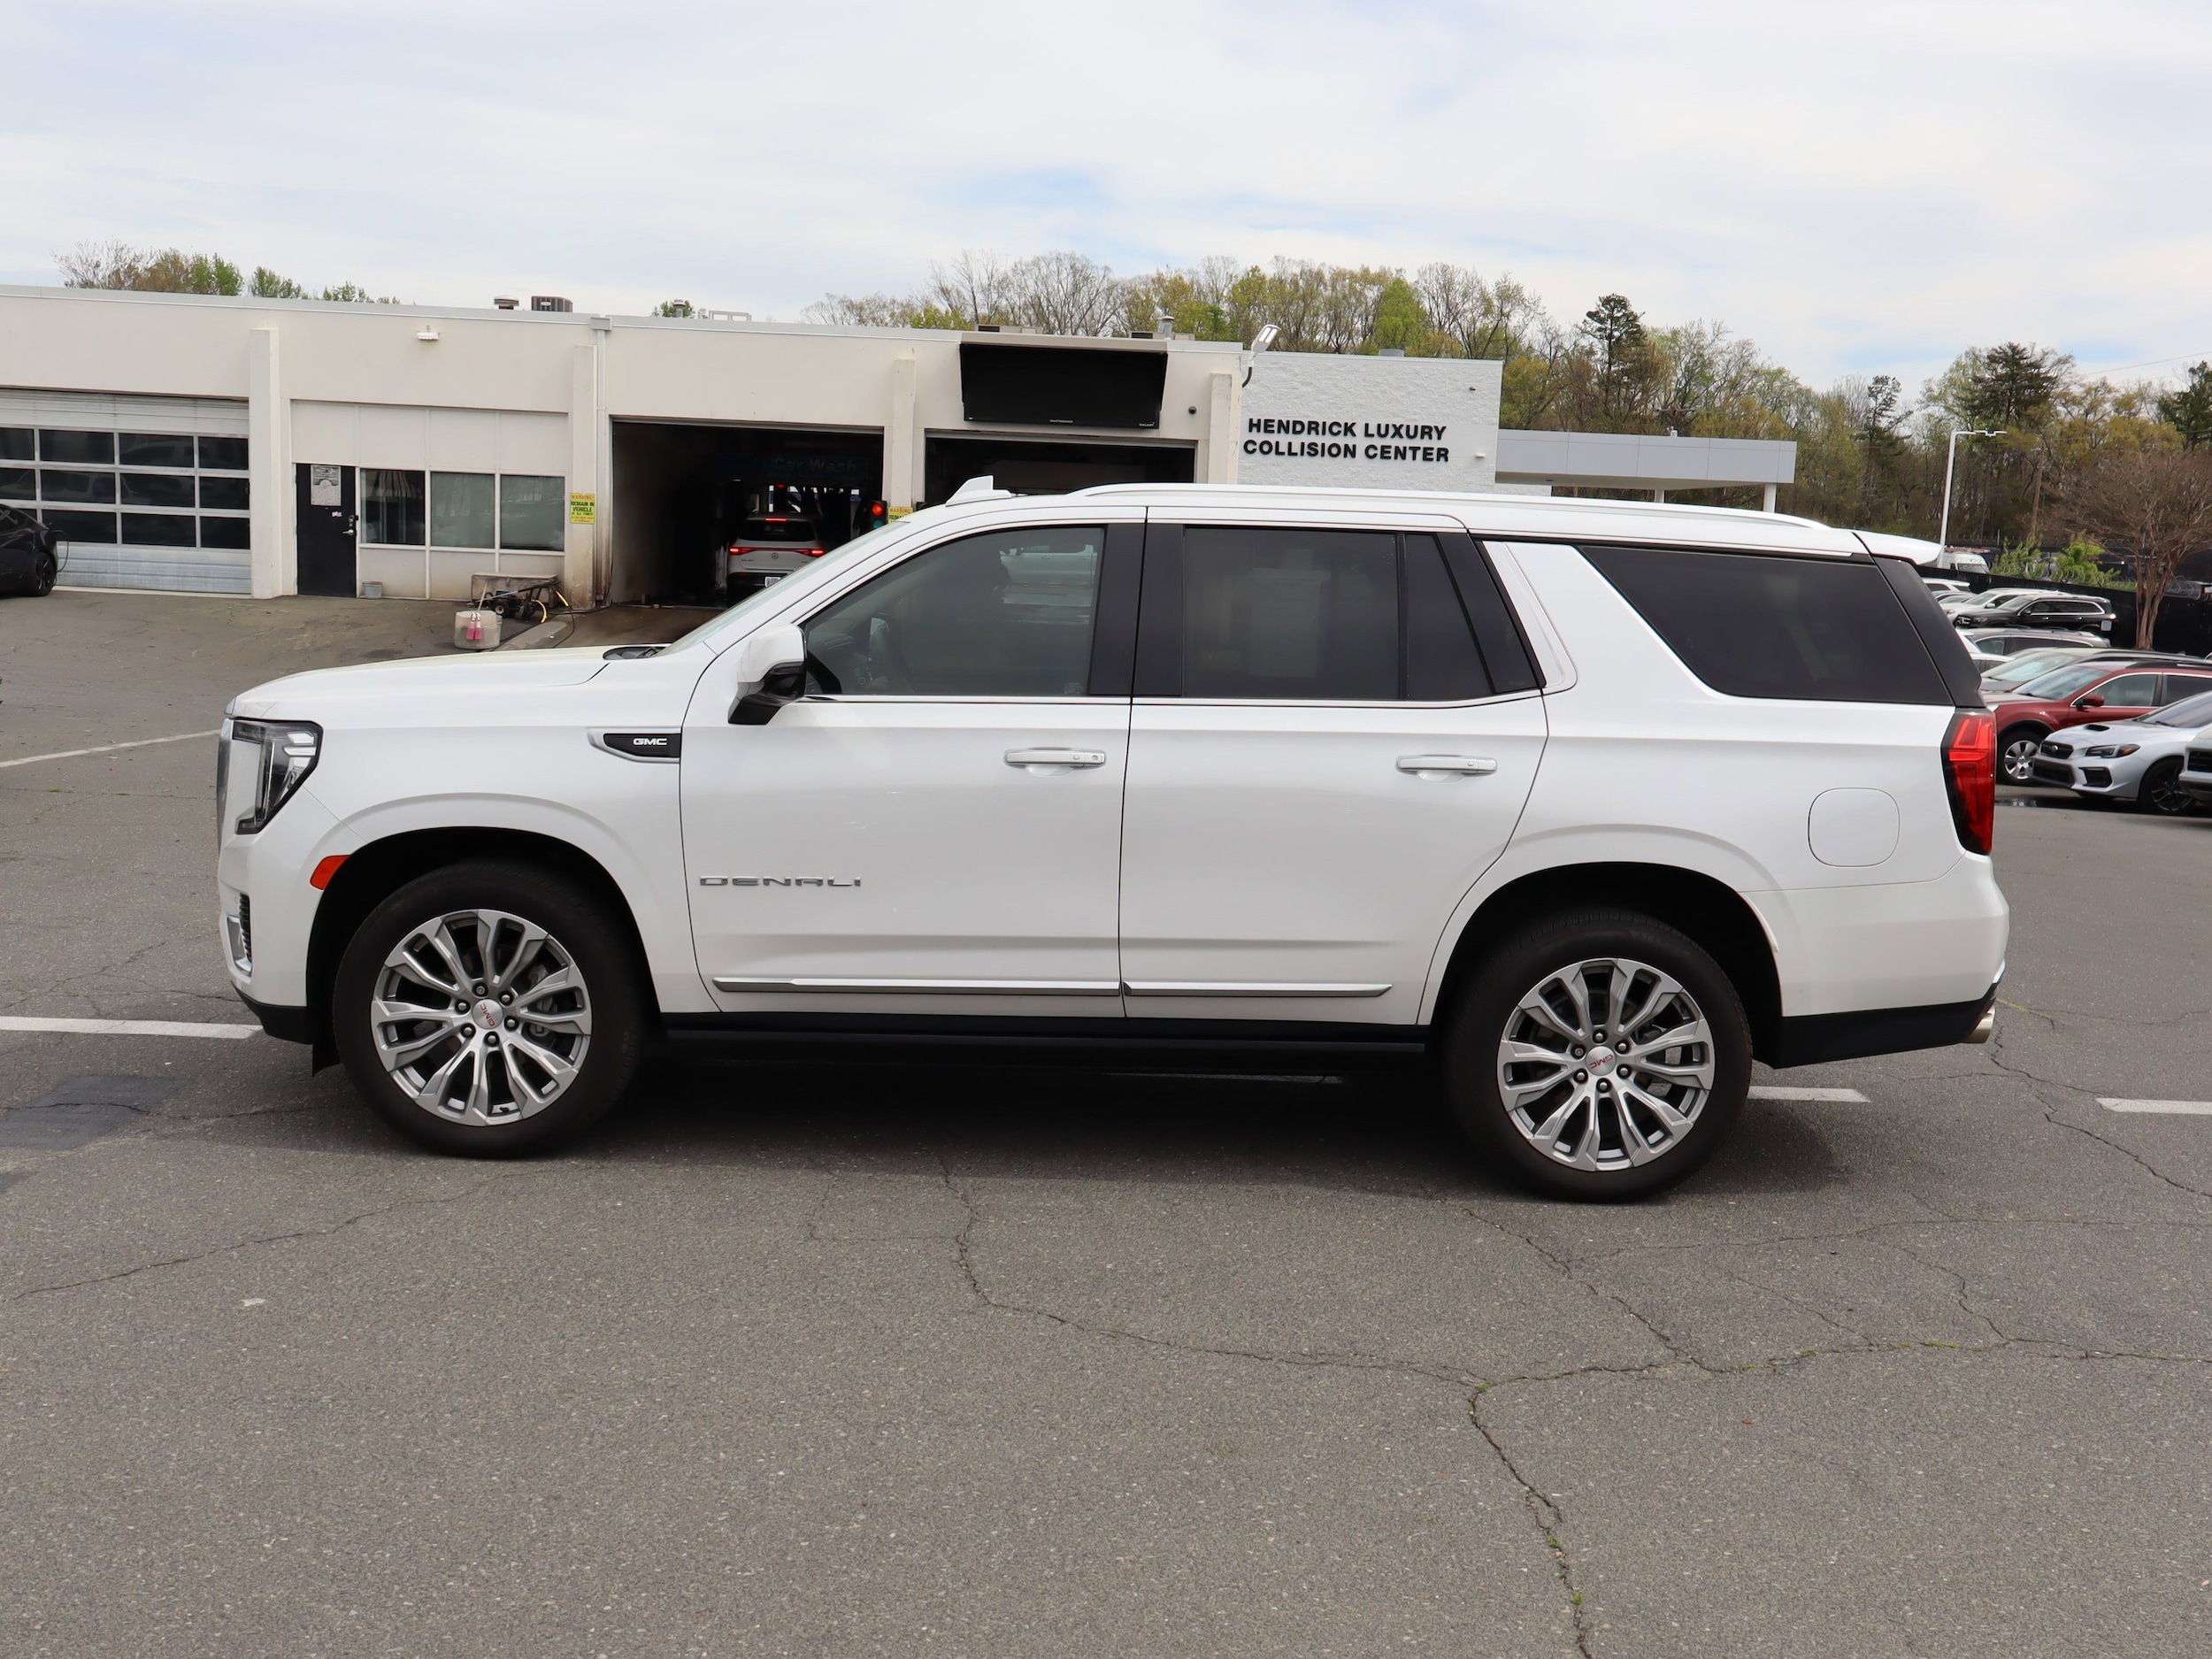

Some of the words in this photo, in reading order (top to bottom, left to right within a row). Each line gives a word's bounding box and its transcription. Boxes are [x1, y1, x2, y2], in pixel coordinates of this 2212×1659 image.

[1248, 419, 1356, 437] HENDRICK
[1364, 423, 1447, 441] LUXURY
[1243, 440, 1356, 458] COLLISION
[1364, 445, 1449, 462] CENTER
[774, 457, 804, 470] Car
[810, 457, 857, 473] Wash
[700, 875, 861, 887] DENALI
[480, 1002, 495, 1026] GMC
[1589, 1054, 1613, 1070] GMC
